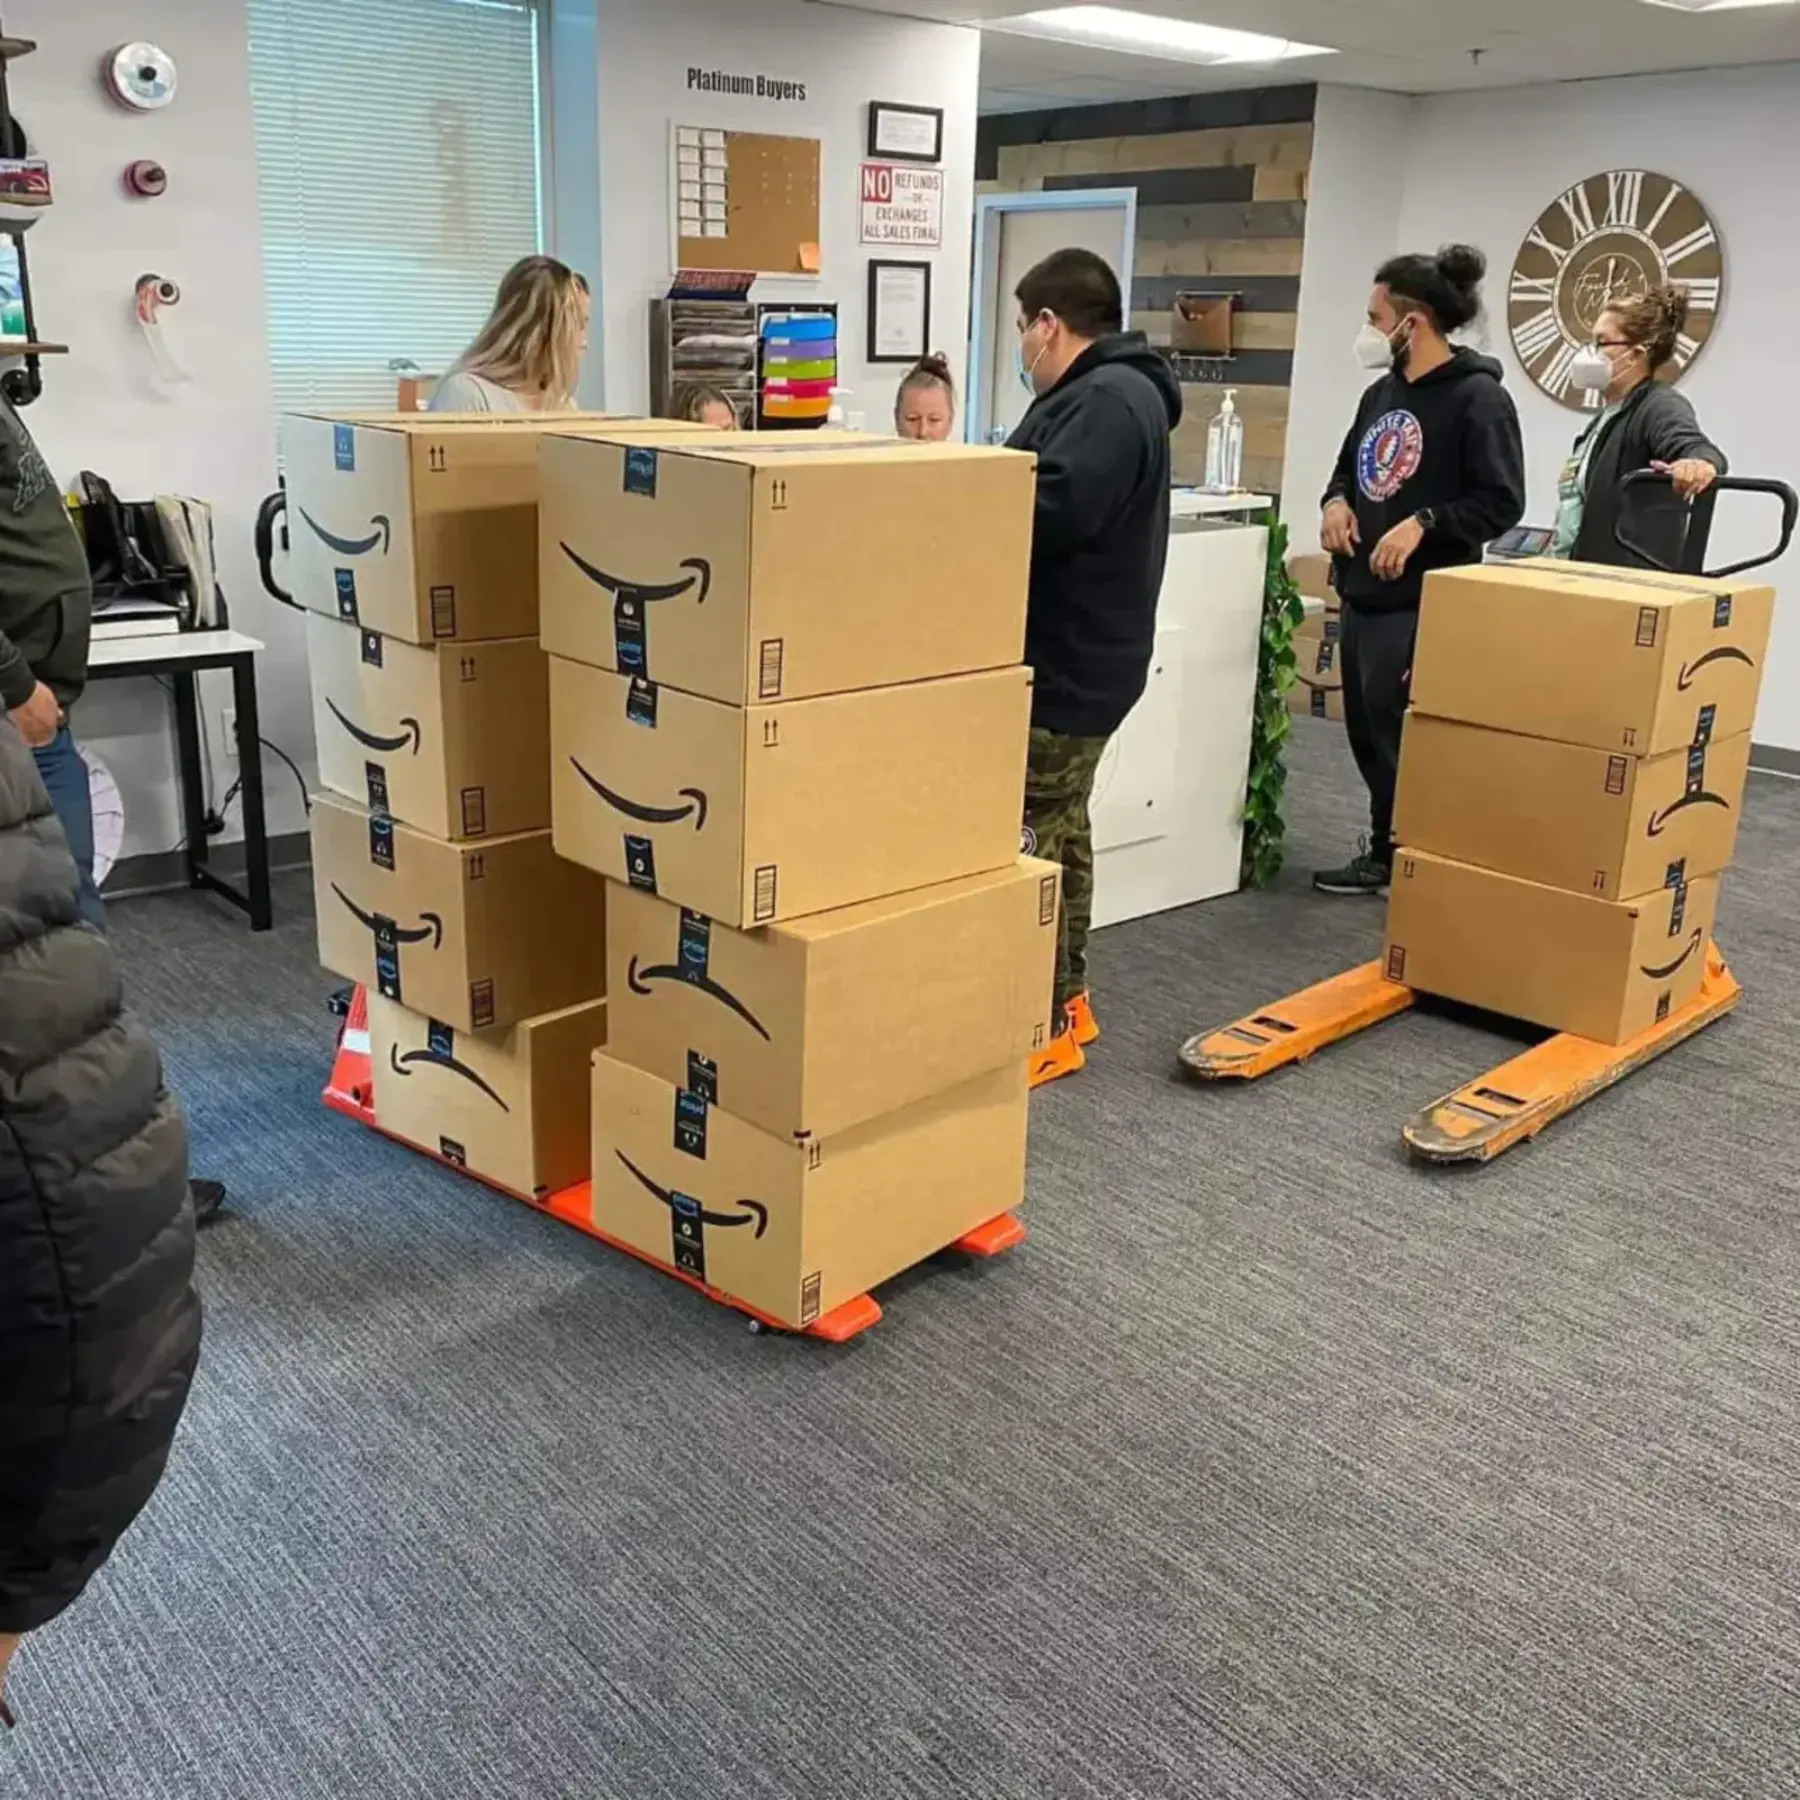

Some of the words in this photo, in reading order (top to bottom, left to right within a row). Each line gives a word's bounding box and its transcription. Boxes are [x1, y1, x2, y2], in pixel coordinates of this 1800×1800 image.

[687, 67, 754, 96] Platinum
[756, 75, 806, 101] Buyers
[864, 168, 890, 199] NO
[895, 173, 939, 191] REFUNDS
[876, 206, 928, 223] EXCHANGES
[864, 224, 881, 239] ALL
[882, 224, 911, 240] SALES
[912, 226, 938, 242] FINAL
